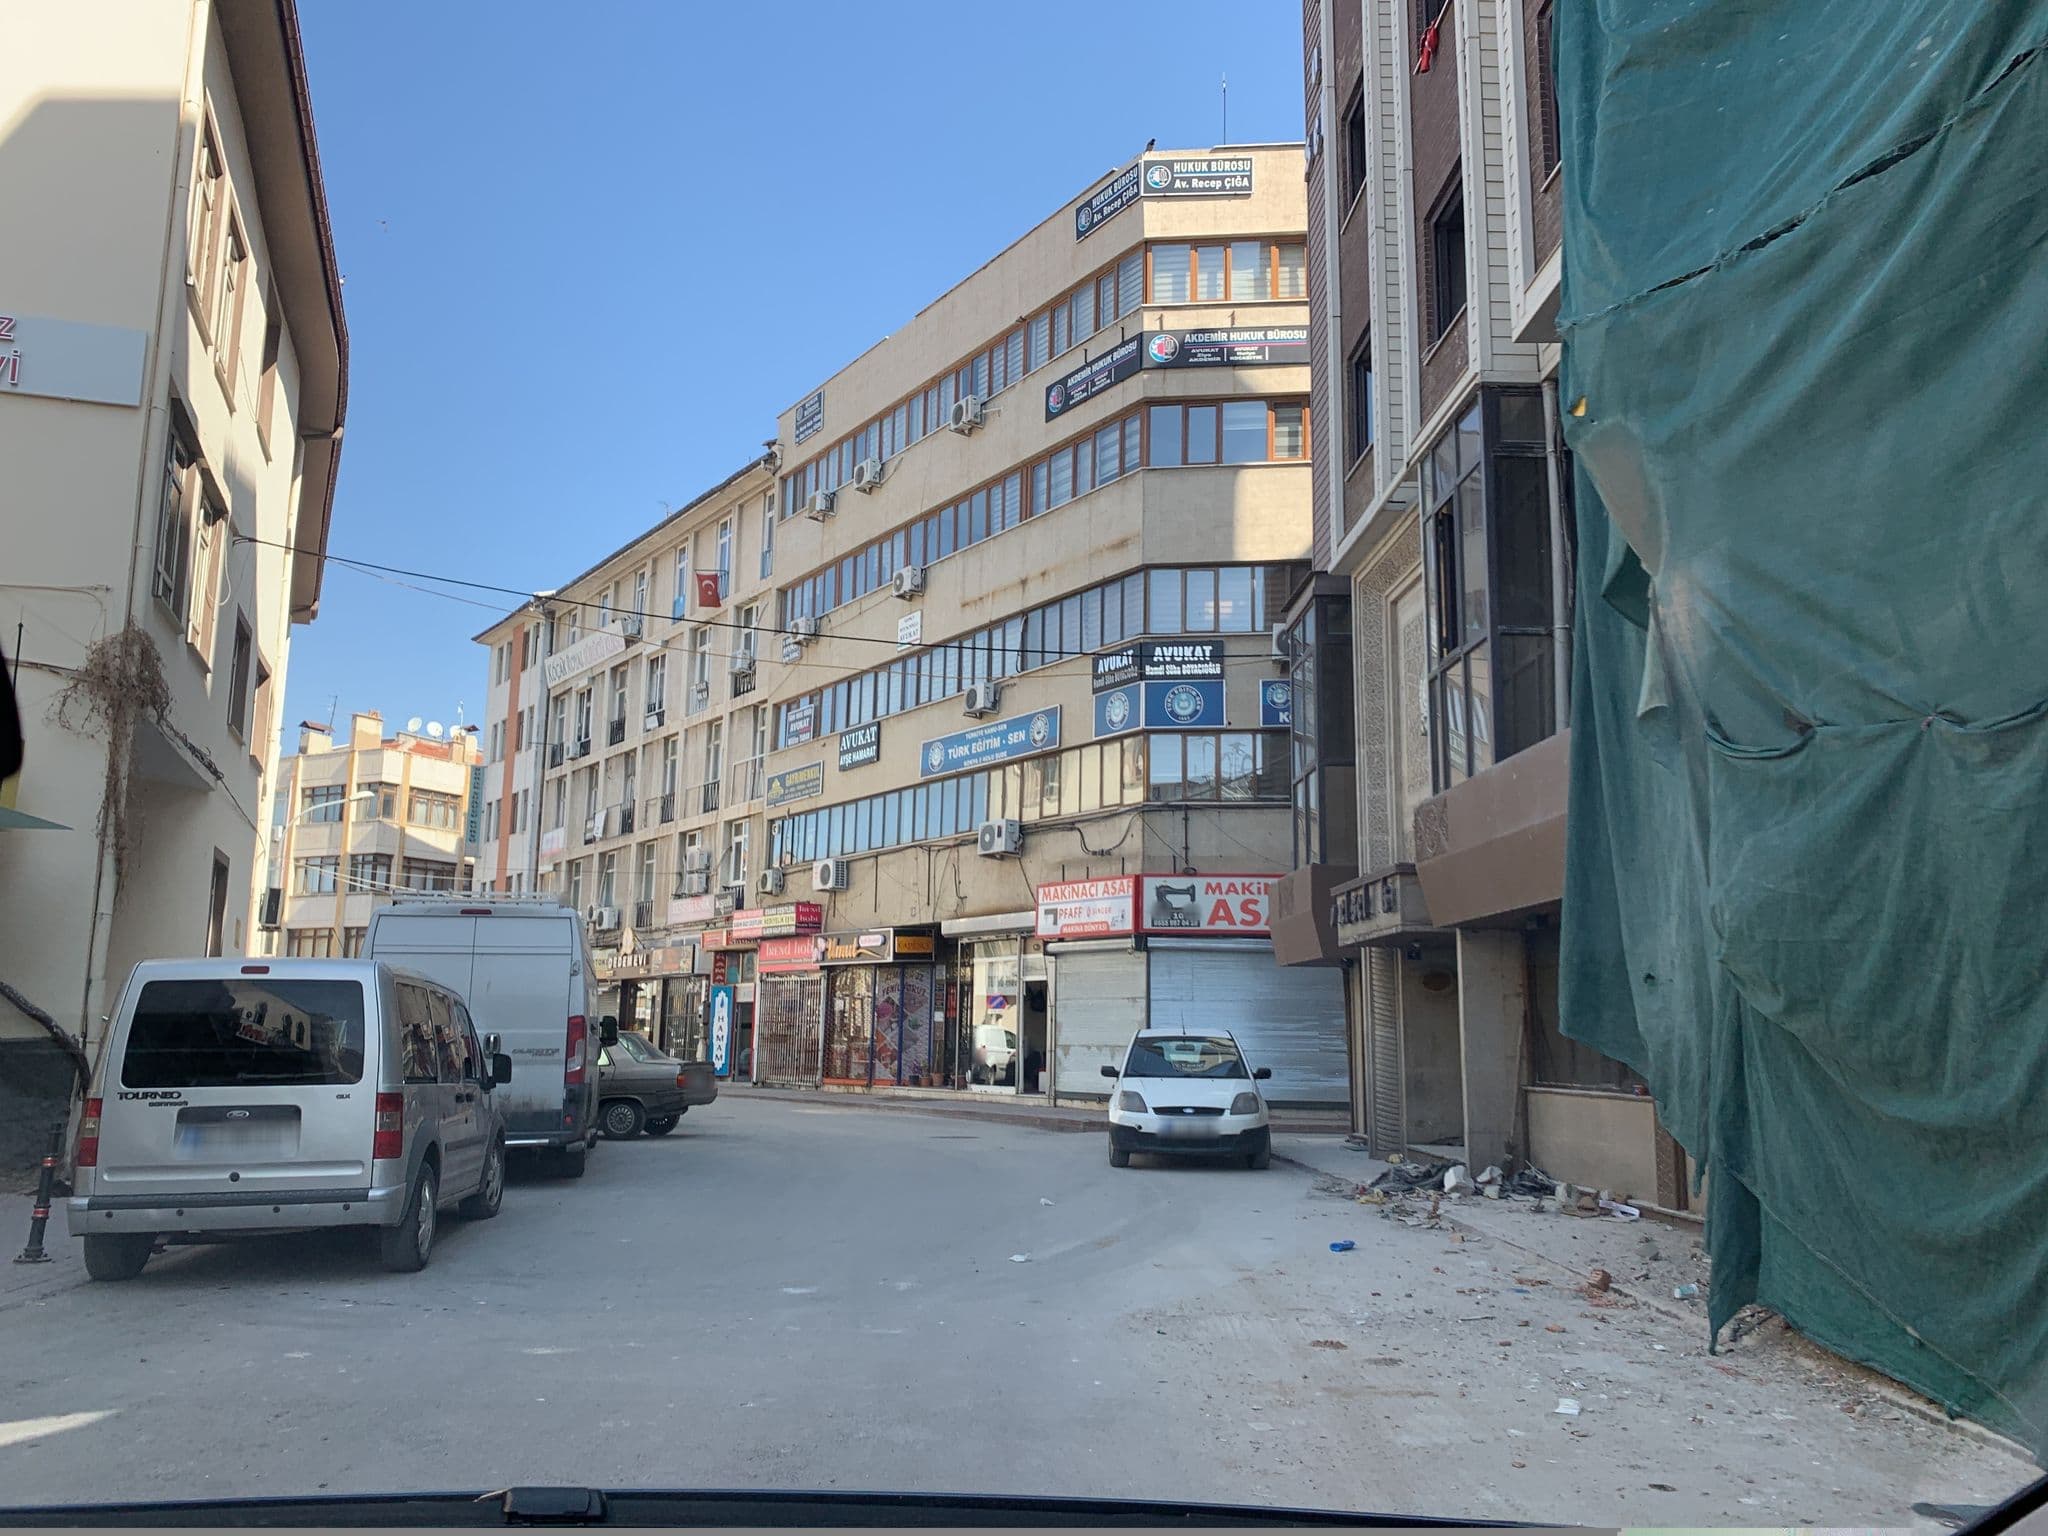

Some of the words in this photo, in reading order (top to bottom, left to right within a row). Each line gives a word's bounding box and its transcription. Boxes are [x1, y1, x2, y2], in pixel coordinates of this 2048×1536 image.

[1173, 161, 1208, 173] HUKUK
[1210, 159, 1251, 172] BÜROSU
[1092, 185, 1113, 209] HUKUK
[1113, 166, 1138, 193] BÜROSU
[1174, 179, 1190, 189] Av.
[1191, 178, 1222, 190] Recep
[1184, 331, 1228, 344] AKDEMİR
[1229, 331, 1265, 342] HUKUK
[1267, 328, 1308, 340] BÜROSU
[1097, 649, 1134, 674] AVUKAT
[1153, 645, 1213, 662] AVUKAT
[840, 725, 878, 751] AVUKAT
[947, 744, 970, 760] TÜRK
[971, 735, 1001, 755] EĞİTİM
[1007, 730, 1026, 746] SEN
[1207, 898, 1270, 927] AS
[714, 1015, 727, 1061] HAMAM
[117, 1090, 182, 1101] TOURNEO
